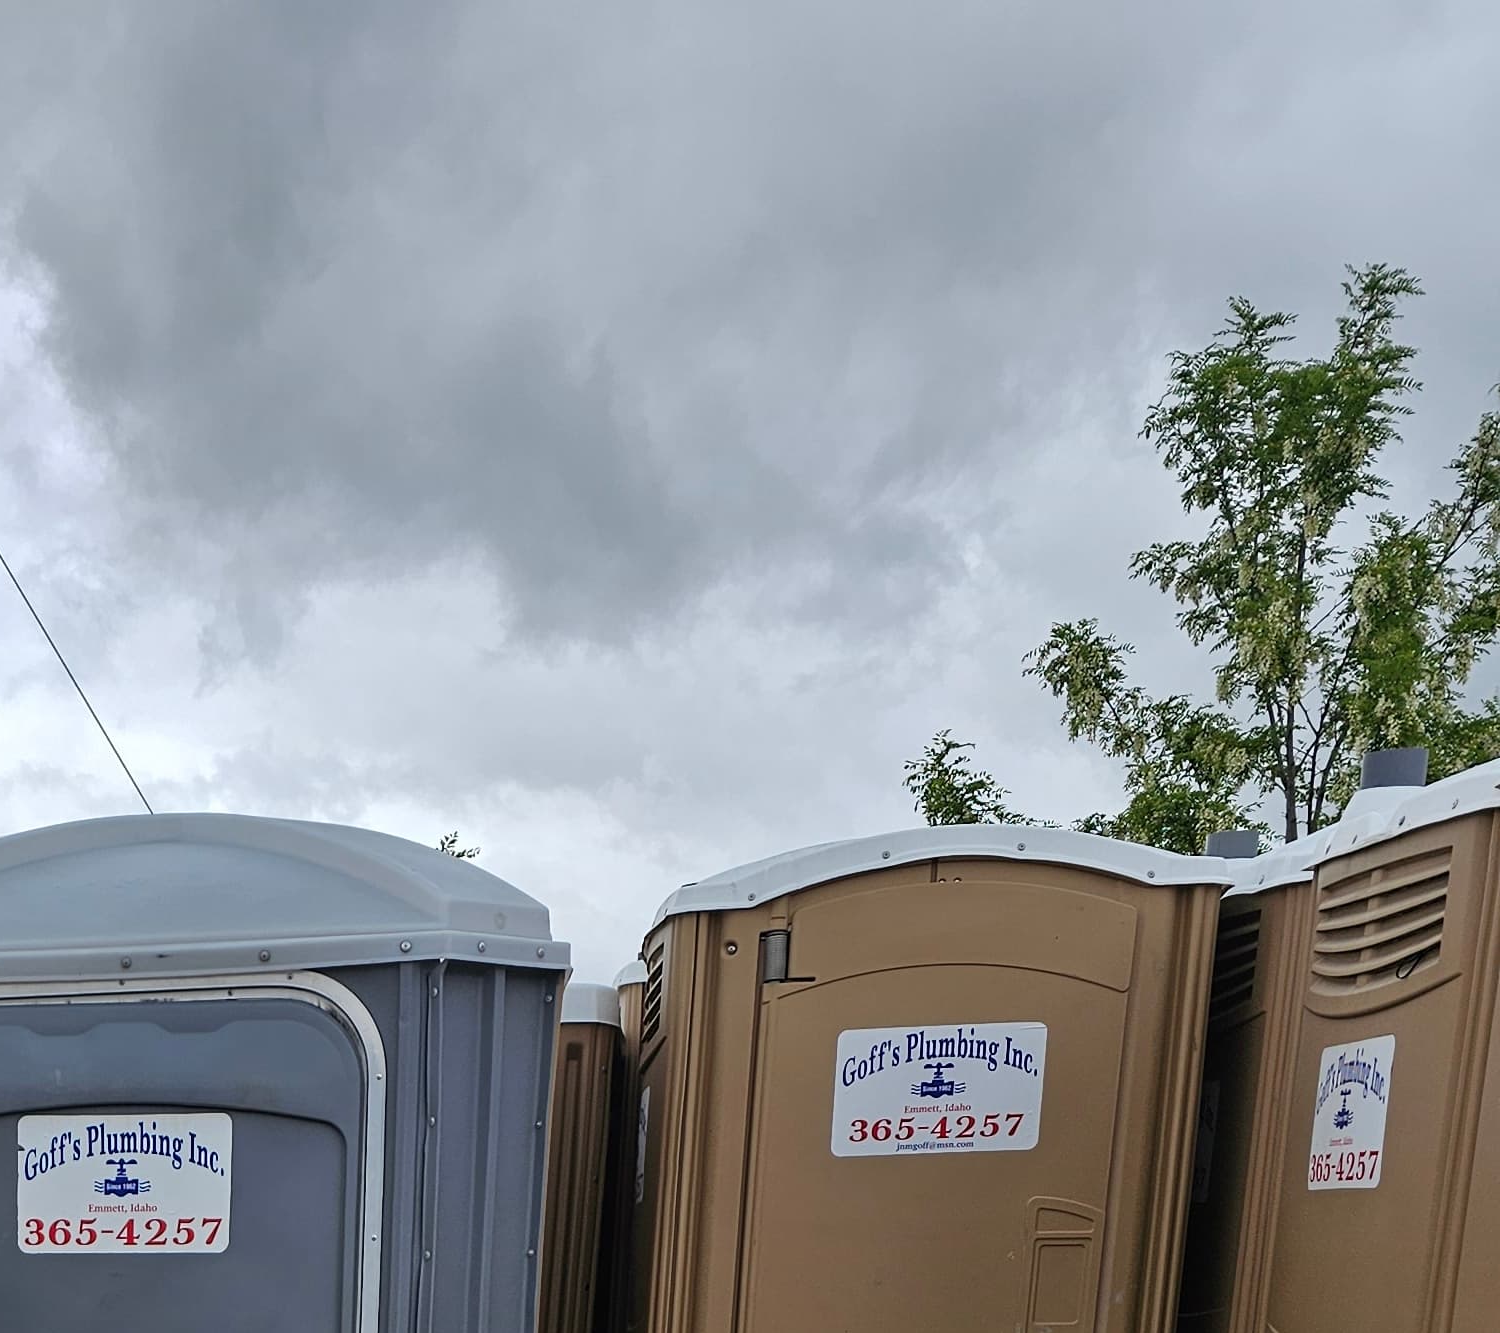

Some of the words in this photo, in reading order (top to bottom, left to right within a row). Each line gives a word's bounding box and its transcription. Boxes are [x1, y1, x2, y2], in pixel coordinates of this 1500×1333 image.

[842, 1040, 900, 1087] Goff's
[905, 1028, 1000, 1072] Plumbing
[1004, 1037, 1038, 1077] Inc.
[1371, 1057, 1387, 1104] Inc.
[904, 1104, 942, 1114] Emmett,
[945, 1103, 971, 1113] Idaho
[849, 1113, 1024, 1143] 365-4257
[24, 1131, 81, 1181] Goff's
[86, 1121, 184, 1170] Plumbing
[188, 1132, 225, 1177] Inc.
[896, 1140, 974, 1152] jnmgoff@msn.com
[1309, 1150, 1380, 1182] 365-4257
[88, 1203, 128, 1214] Emmett,
[130, 1203, 158, 1213] Idaho
[24, 1217, 223, 1246] 365-4257
